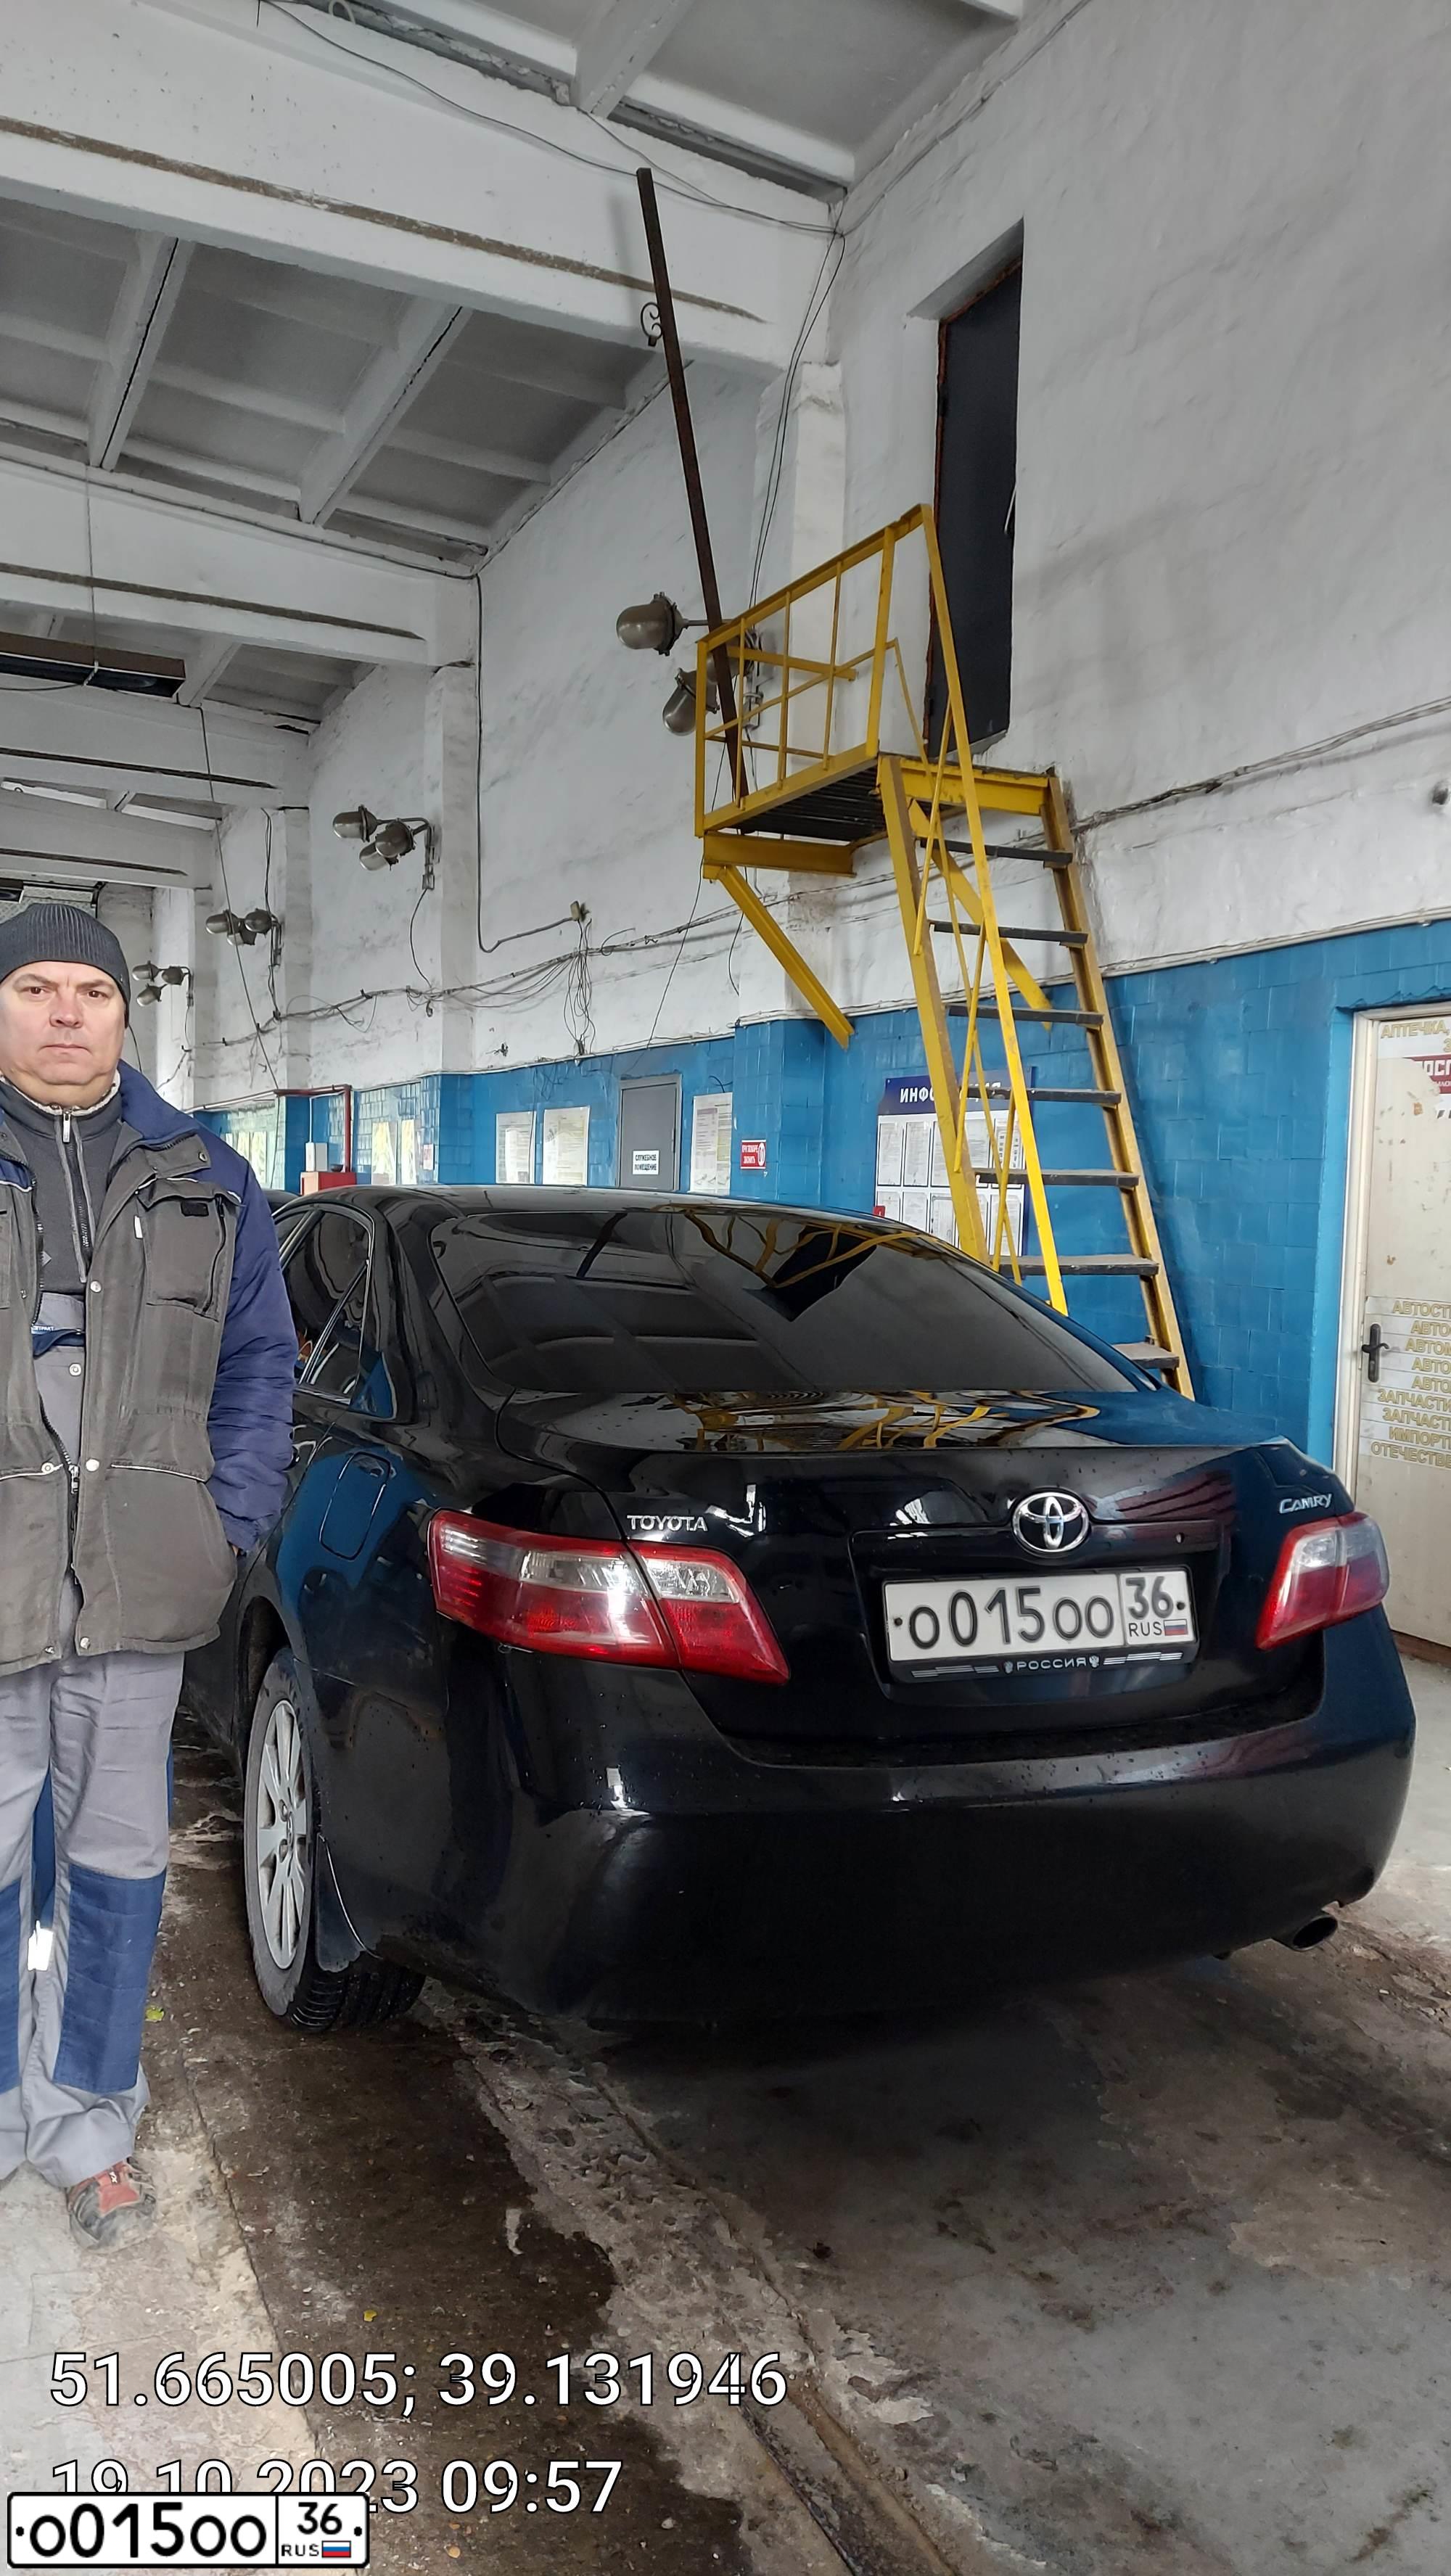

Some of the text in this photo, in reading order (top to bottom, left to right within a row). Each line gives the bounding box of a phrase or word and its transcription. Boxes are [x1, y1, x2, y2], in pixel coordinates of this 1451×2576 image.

[1381, 1020, 1450, 1039] АПТЕЧКА,
[1392, 1300, 1451, 1320] АВТОСТ
[1410, 1320, 1451, 1337] АВТО
[1389, 1426, 1451, 1450] ИМПОРТ
[1279, 1493, 1332, 1515] CAMRY
[626, 1514, 708, 1532] TOYOTA
[1125, 1575, 1175, 1620] 36
[1128, 1621, 1163, 1638] RUS
[1016, 1657, 1088, 1671] РОССИЯ
